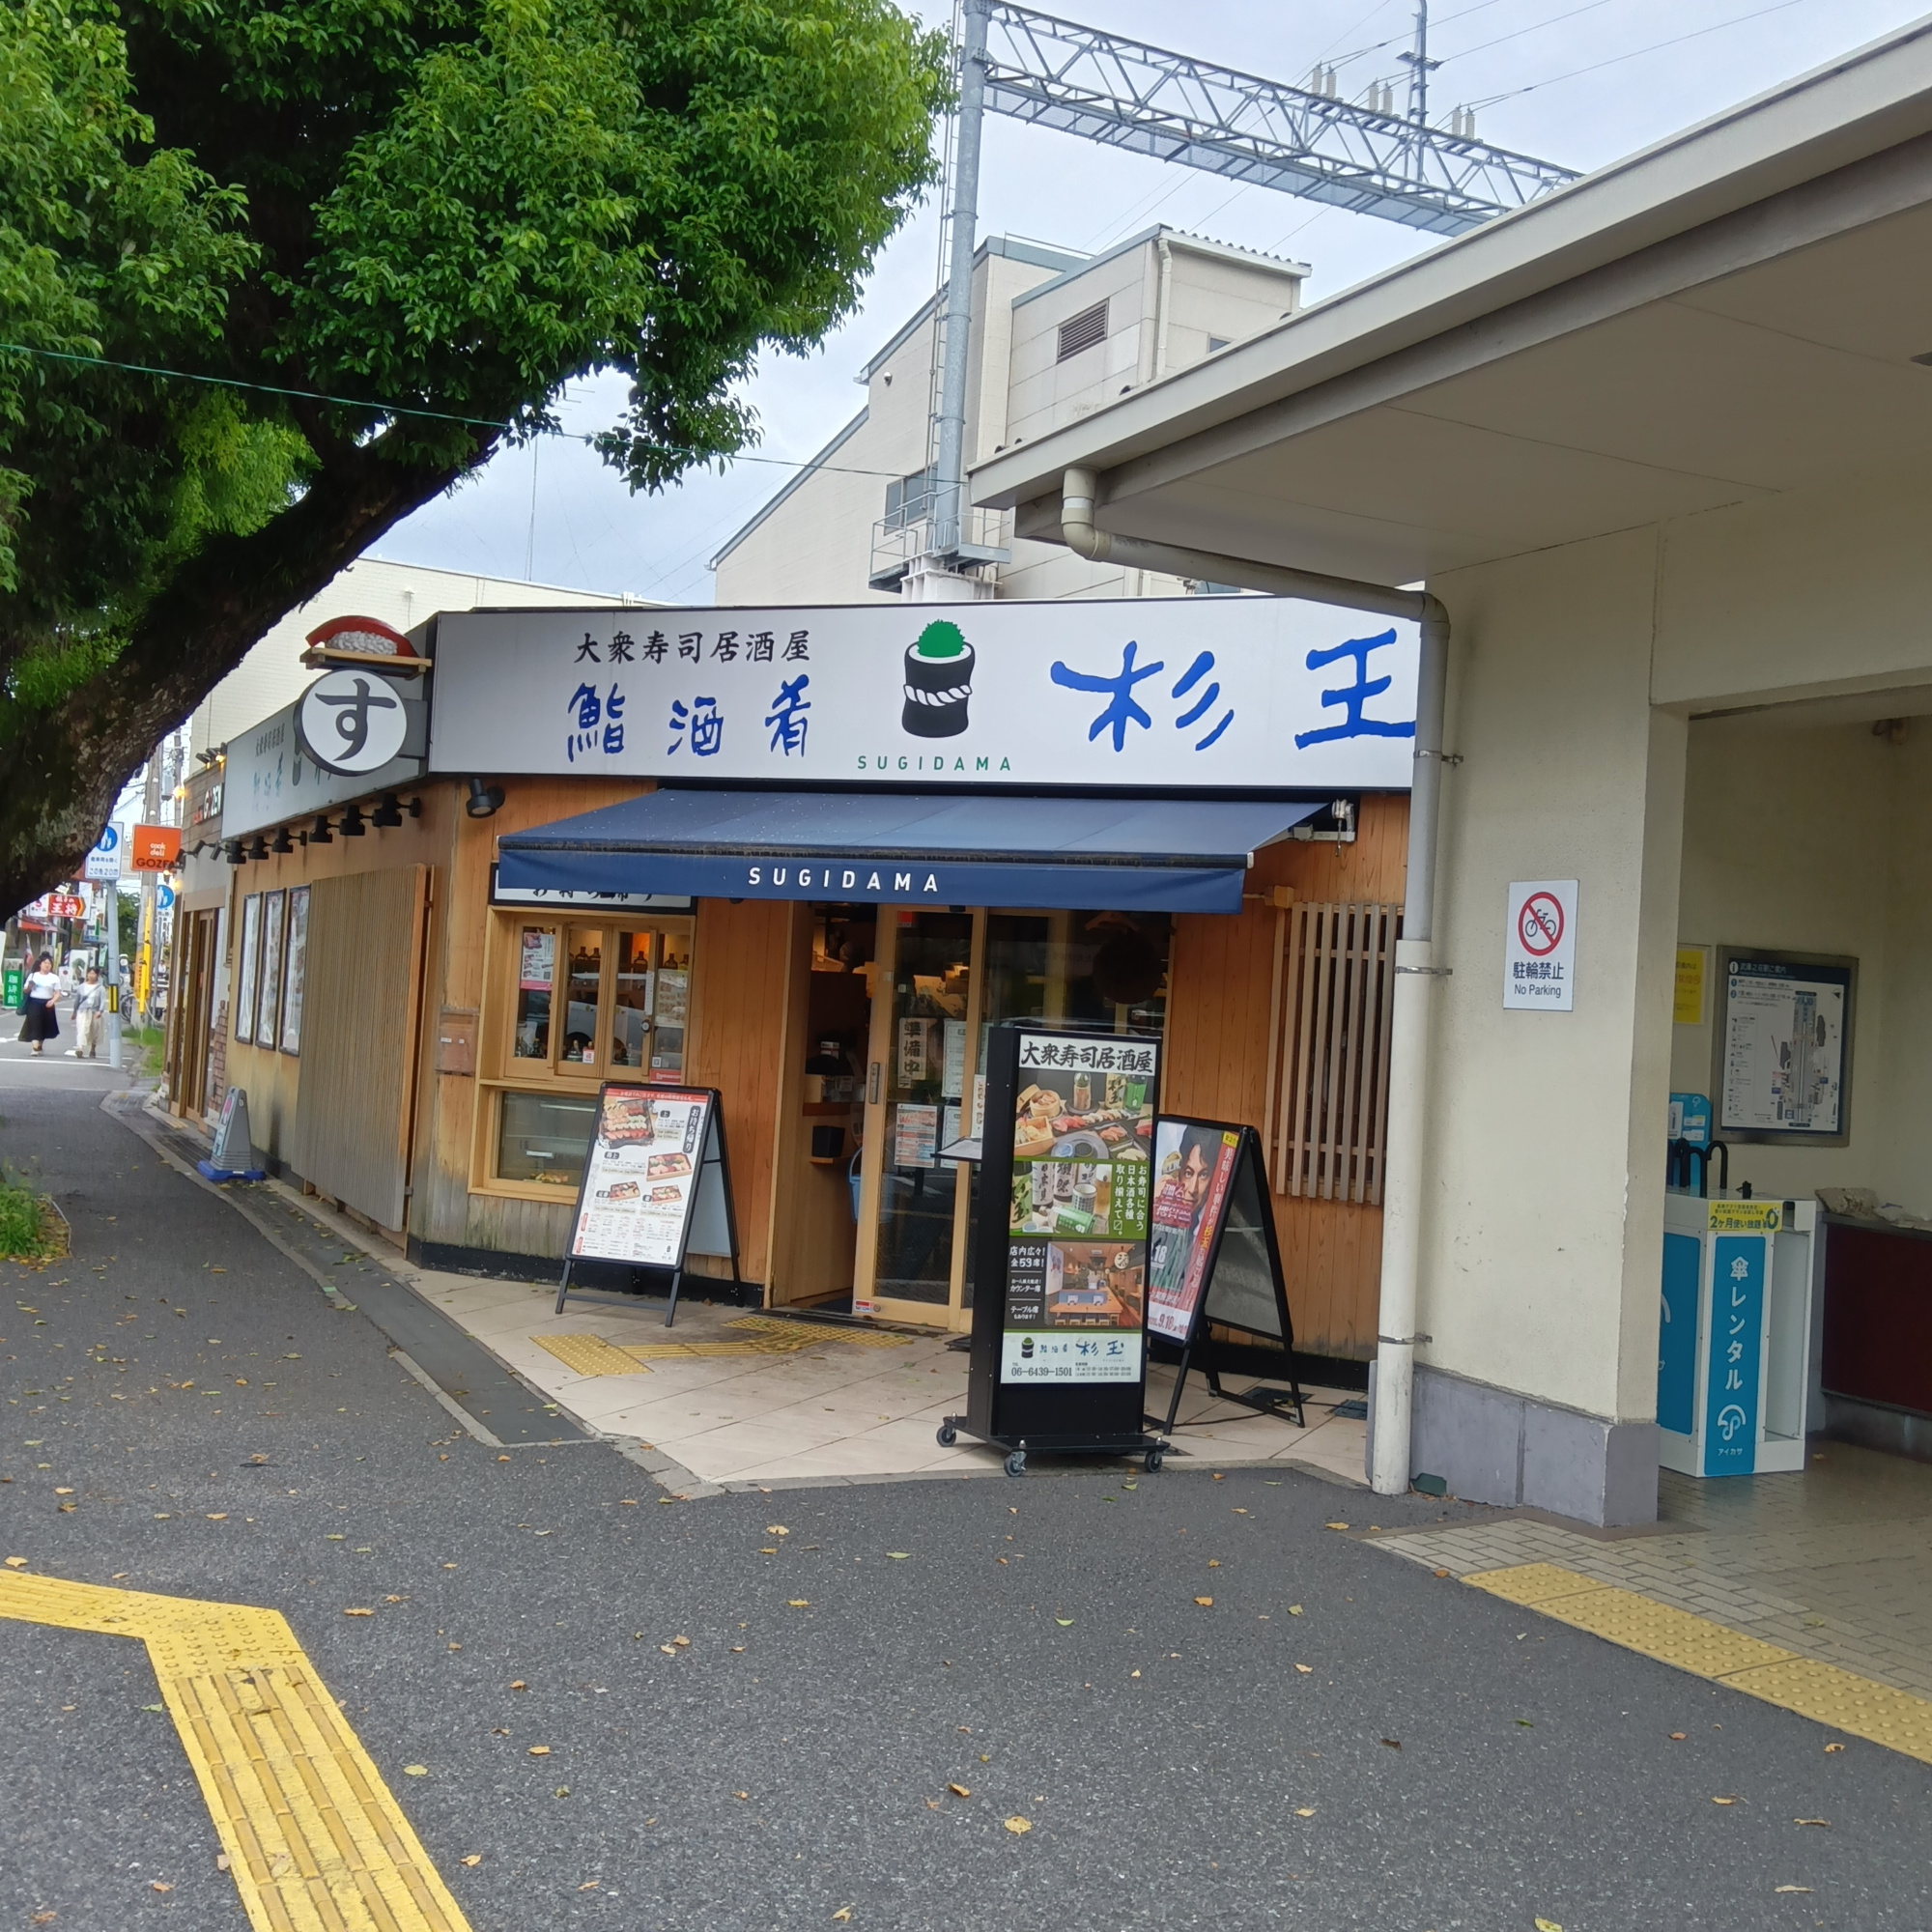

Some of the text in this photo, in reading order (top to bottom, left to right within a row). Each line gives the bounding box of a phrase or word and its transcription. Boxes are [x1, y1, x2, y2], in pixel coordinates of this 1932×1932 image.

[573, 630, 810, 664] 大衆寿司居酒屋
[314, 677, 397, 763] す
[566, 674, 811, 763] 鮨酒肴
[857, 755, 1011, 772] SUGIDAMA
[748, 867, 938, 893] SUGIDAMA
[50, 902, 78, 916] 王将
[1513, 961, 1564, 980] 駐輪禁止
[1514, 984, 1561, 999] No Parking
[903, 1021, 922, 1076] 準備中
[1020, 1041, 1154, 1073] 大衆寿司居酒屋
[1124, 1164, 1136, 1220] 日本酒各種
[1136, 1164, 1148, 1232] お寿司に合う
[1009, 1245, 1046, 1257] 店内広々！
[1725, 1256, 1749, 1390] 傘レンタル
[1075, 1340, 1124, 1356] 杉玉
[1011, 1367, 1072, 1377] 06-6439-1501
[1718, 1447, 1744, 1456] アイカサ
